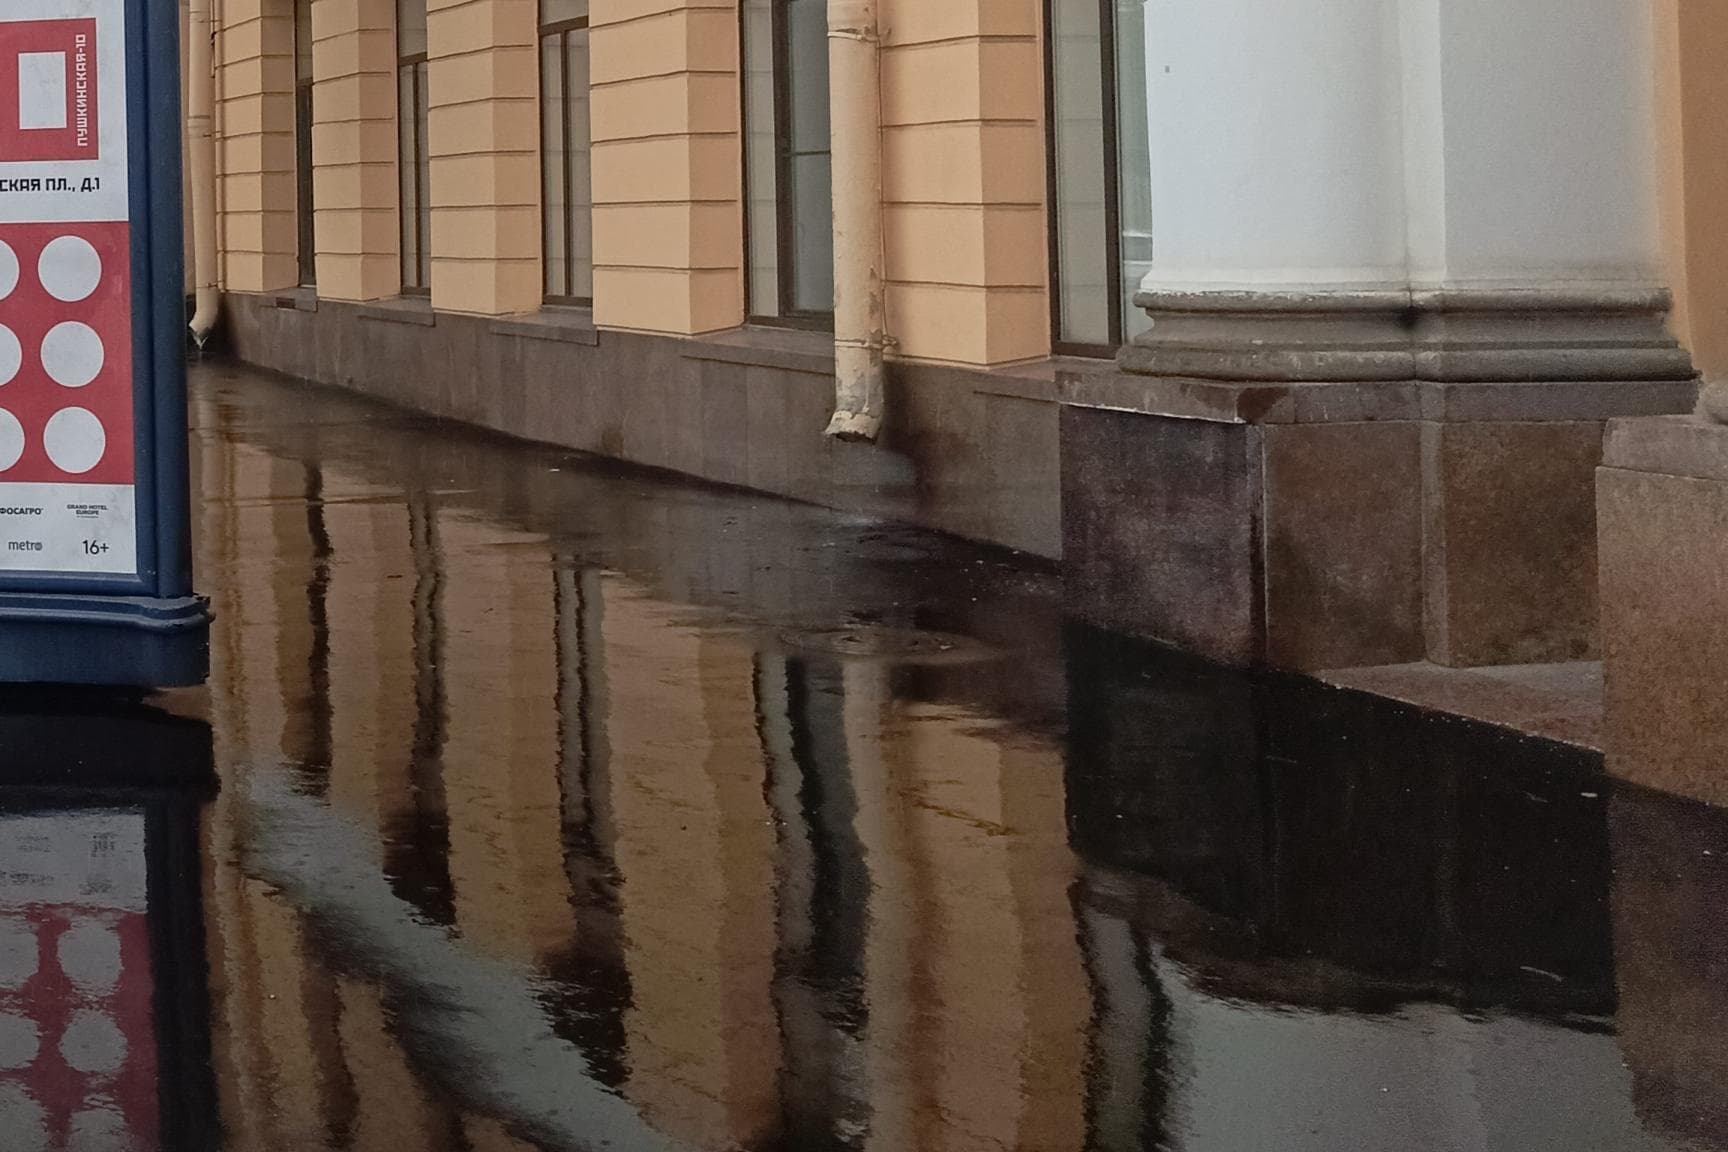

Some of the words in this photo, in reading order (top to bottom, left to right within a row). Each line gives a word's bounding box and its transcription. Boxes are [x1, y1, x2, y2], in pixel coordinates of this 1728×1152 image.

[75, 34, 89, 147] ПУШКИНСКАЯ-10
[46, 177, 75, 192] ПЛ.,
[81, 177, 100, 192] Д.1
[8, 540, 43, 551] metro
[82, 539, 110, 555] 16+
